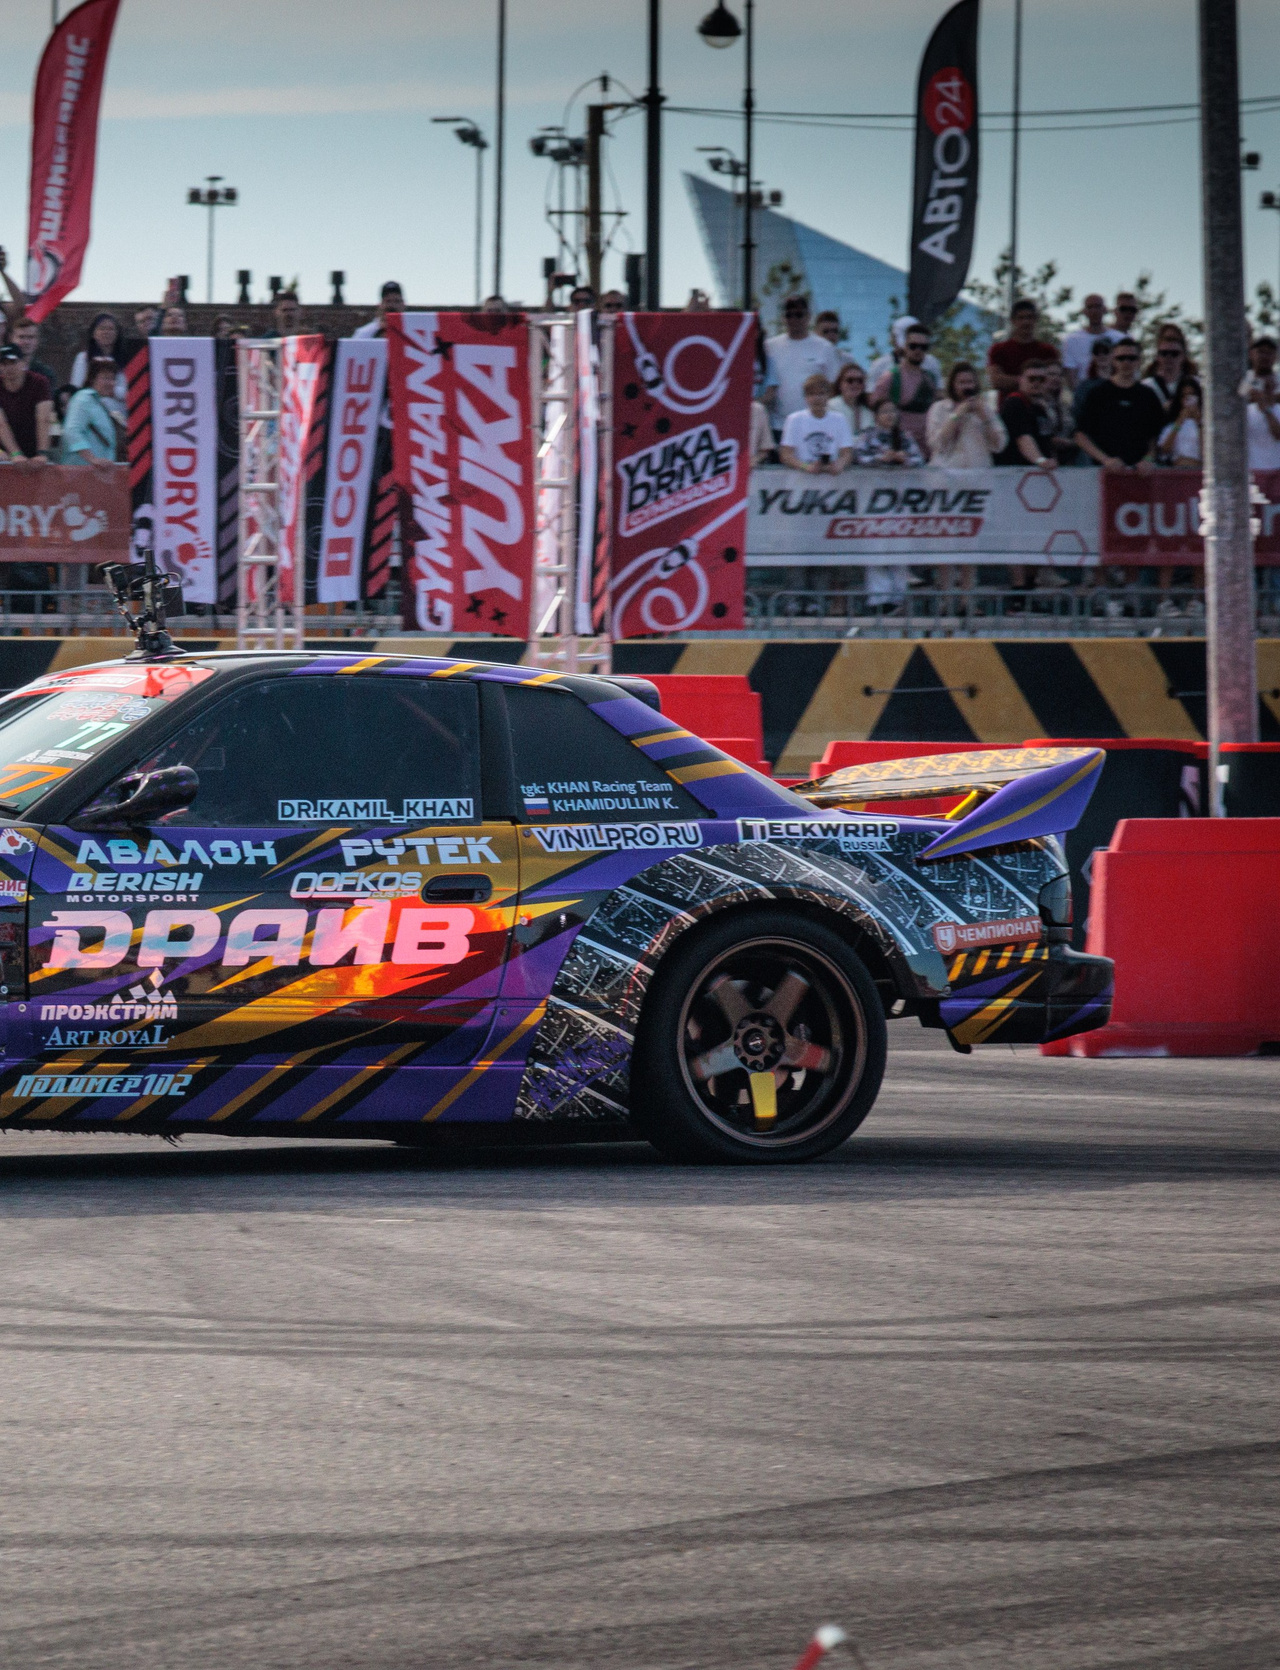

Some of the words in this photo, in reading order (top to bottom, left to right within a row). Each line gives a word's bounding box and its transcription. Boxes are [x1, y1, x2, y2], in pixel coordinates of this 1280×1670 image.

[163, 356, 199, 535] DRYDRY
[623, 429, 715, 486] YUKA
[402, 312, 454, 632] GYMKHANA
[453, 343, 525, 601] YUKA
[627, 445, 733, 513] DRIVE
[757, 488, 858, 516] YUKA
[864, 488, 993, 515] DRIVE
[53, 721, 131, 750] 77
[520, 782, 546, 797] tgk:
[548, 781, 591, 794] KHAN
[592, 780, 637, 795] Racing
[639, 780, 673, 793] Team
[552, 797, 661, 812] KHAMIDULLIN
[664, 797, 680, 810] K.
[843, 840, 890, 851] RUSSIA
[66, 872, 204, 892] BERISH
[66, 894, 200, 903] MOTORSPORT
[956, 919, 1042, 942] ЧЕМПИОНАТ
[39, 1004, 178, 1021] ПРОЭКСТРИМ
[44, 1025, 95, 1047] ART
